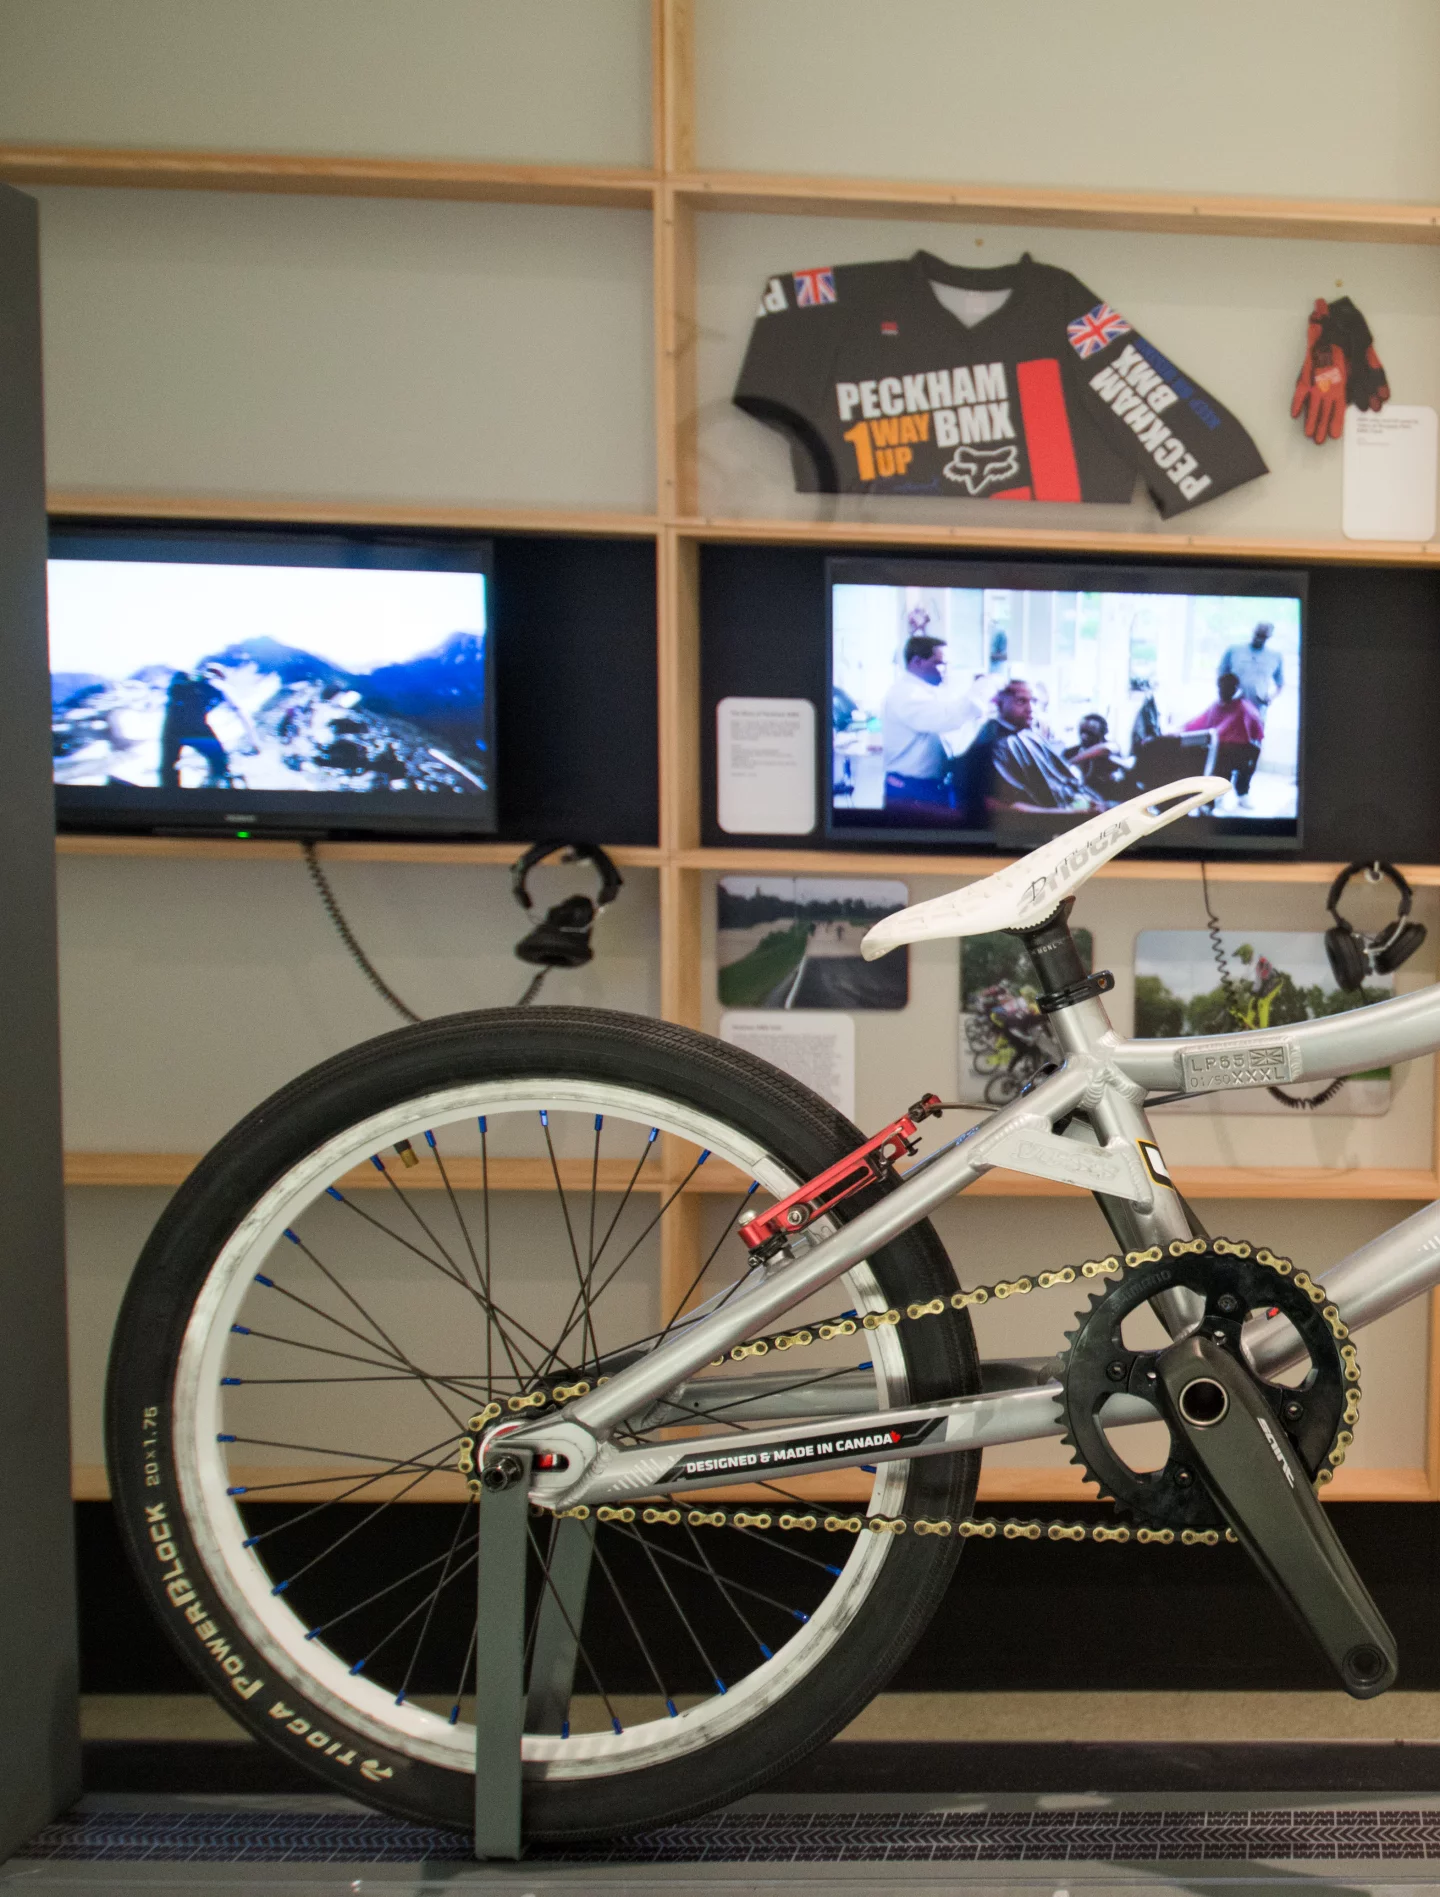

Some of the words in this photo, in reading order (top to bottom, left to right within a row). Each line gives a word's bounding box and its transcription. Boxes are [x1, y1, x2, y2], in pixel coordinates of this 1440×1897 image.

[836, 362, 1008, 421] PECKHAM
[1110, 344, 1179, 415] BMX
[843, 421, 876, 481] 1
[870, 412, 929, 448] WAY
[933, 401, 1015, 448] BMX
[1088, 366, 1212, 501] PECKHAM
[875, 445, 914, 478] UP
[1191, 1054, 1245, 1072] LP65
[686, 1453, 757, 1474] DESIGNED
[759, 1449, 771, 1464] &
[773, 1444, 815, 1461] MADE
[817, 1441, 834, 1456] IN
[835, 1432, 893, 1452] CANADA
[268, 1699, 361, 1767] TIOGA
